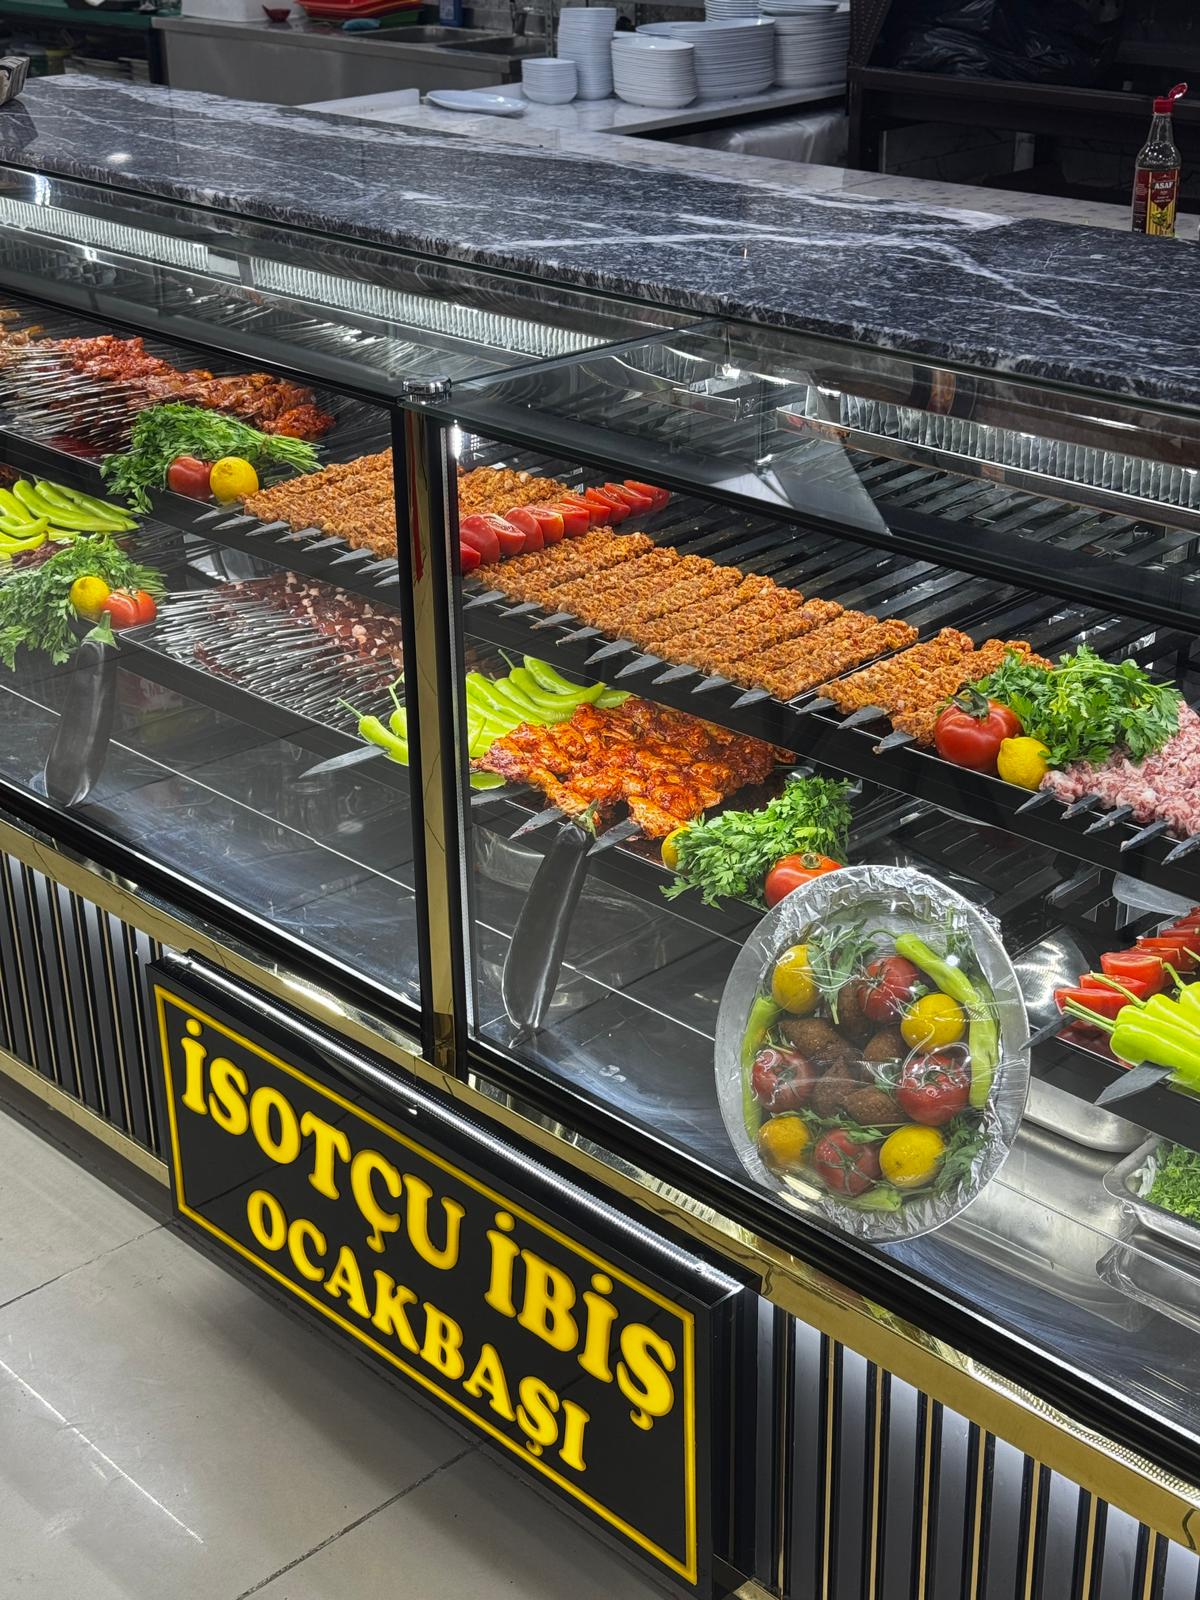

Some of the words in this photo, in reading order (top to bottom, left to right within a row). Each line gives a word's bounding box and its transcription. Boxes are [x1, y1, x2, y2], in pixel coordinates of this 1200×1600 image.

[180, 1018, 466, 1270] İSOTÇU
[484, 1211, 676, 1431] İBİŞ
[246, 1190, 591, 1472] OCAKBAŞI
